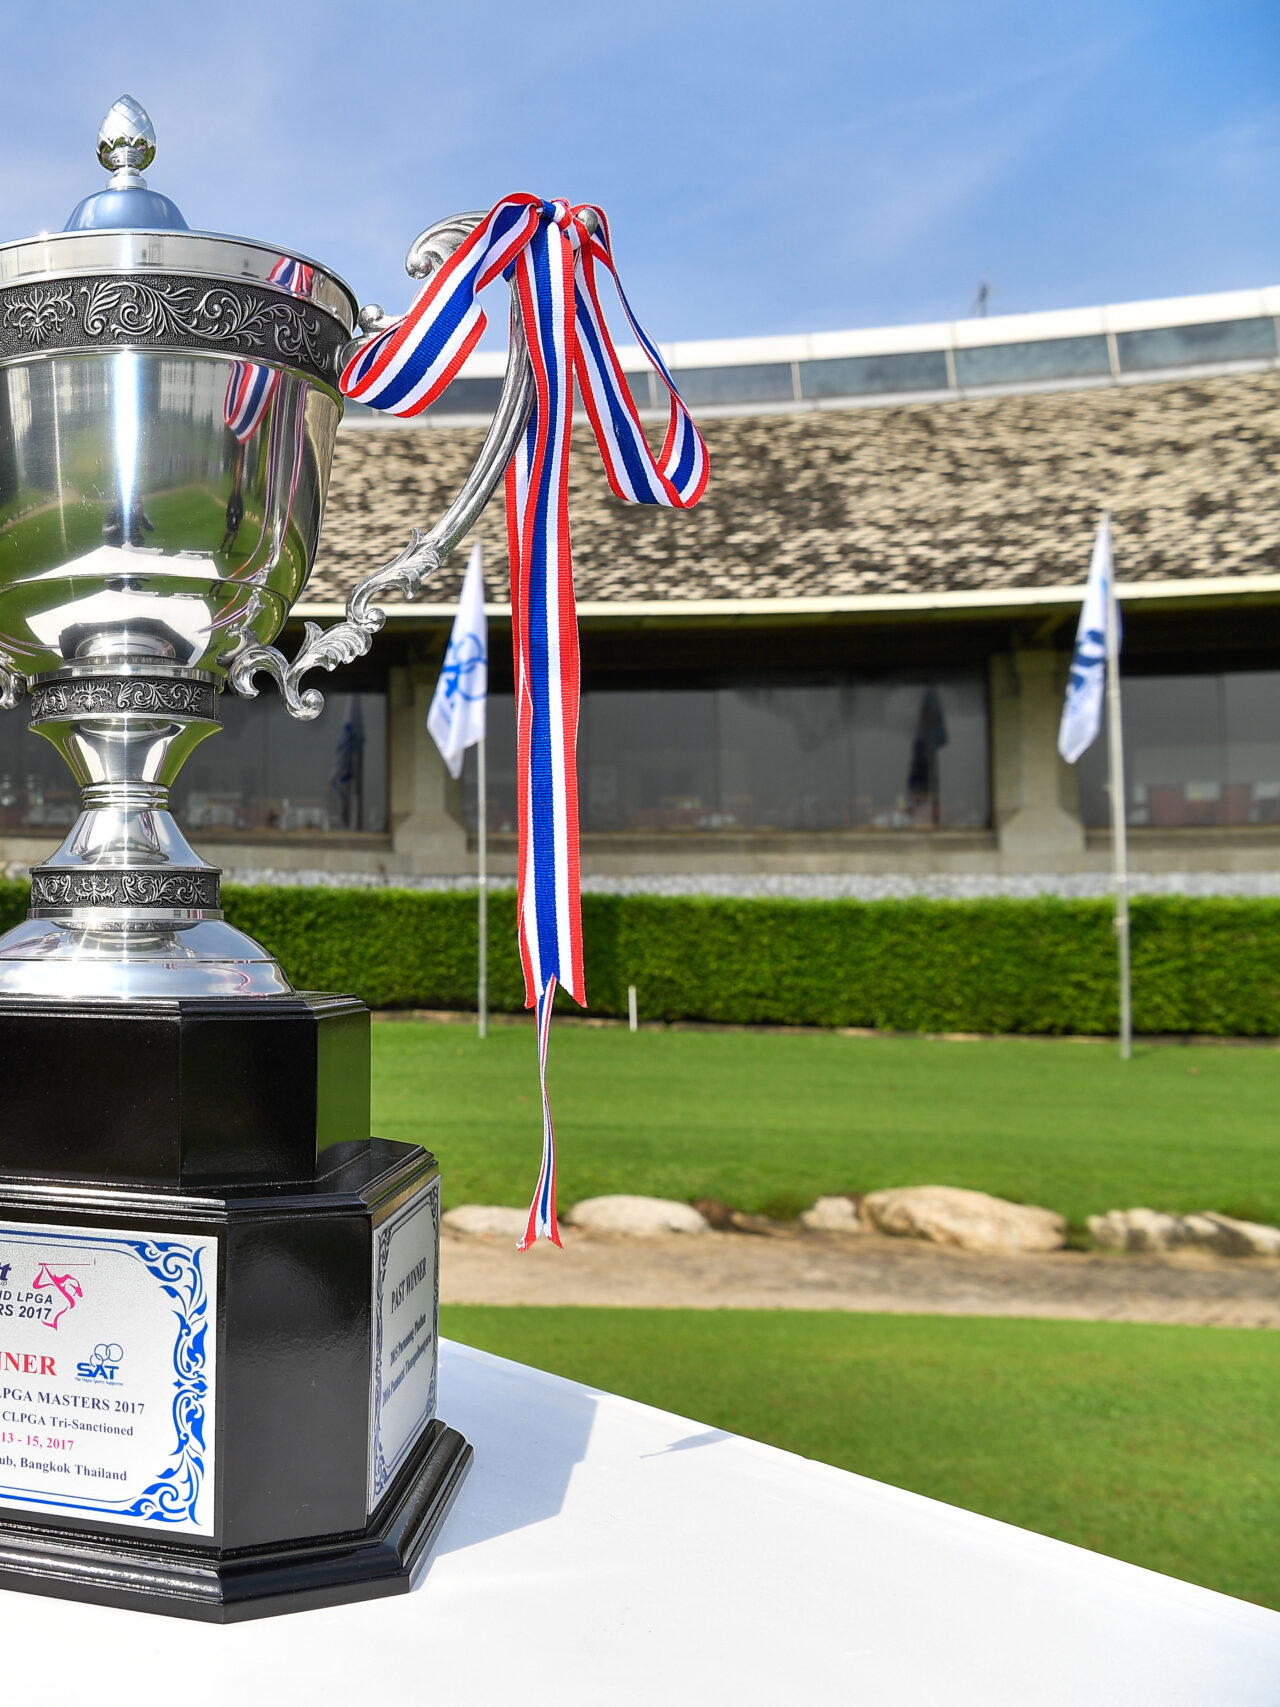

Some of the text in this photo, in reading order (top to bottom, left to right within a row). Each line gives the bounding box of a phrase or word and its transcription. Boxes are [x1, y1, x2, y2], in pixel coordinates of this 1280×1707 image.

[391, 1279, 405, 1313] PAST
[406, 1257, 426, 1296] WINNER
[17, 1292, 53, 1304] LPGA
[18, 1305, 52, 1320] 2017
[76, 1362, 119, 1380] SAT
[38, 1391, 110, 1411] MASTERS
[114, 1400, 145, 1415] 2017
[2, 1411, 46, 1425] CLPGA
[50, 1416, 133, 1436] Tri-Sanctioned
[1, 1432, 14, 1443] 13
[27, 1435, 43, 1448] 15,
[47, 1437, 74, 1451] 2017
[20, 1457, 70, 1473] Bangkok
[74, 1464, 127, 1481] Thailand
